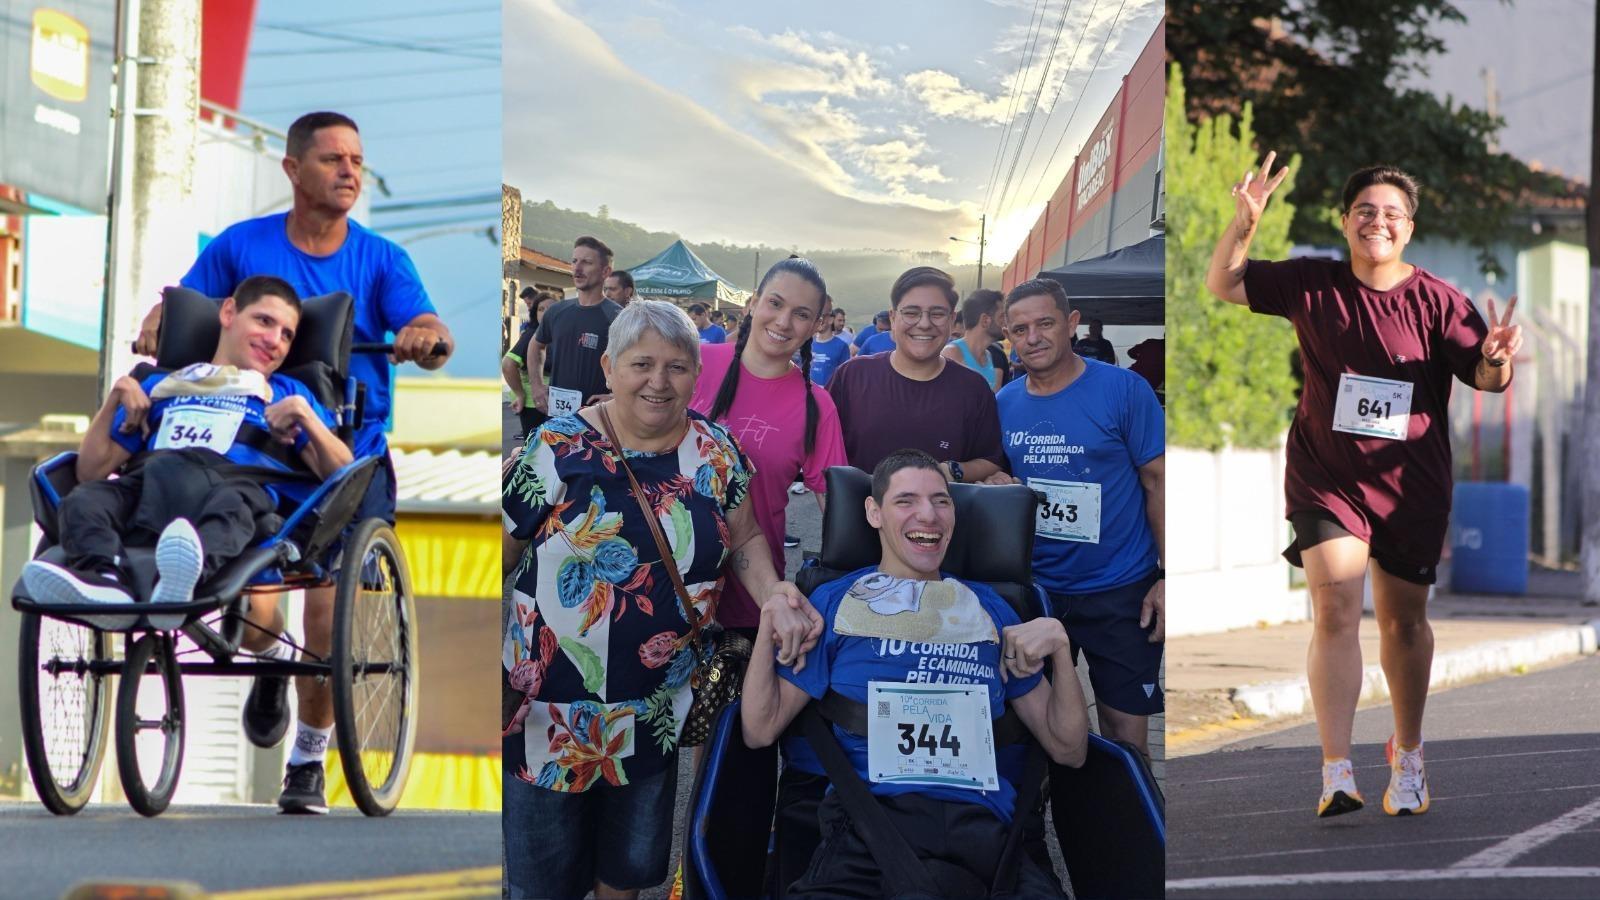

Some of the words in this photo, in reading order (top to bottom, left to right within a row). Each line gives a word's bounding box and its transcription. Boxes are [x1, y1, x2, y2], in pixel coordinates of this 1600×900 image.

[555, 399, 572, 412] 534
[1357, 397, 1392, 420] 641
[170, 425, 213, 443] 344
[1024, 434, 1066, 445] CORRIDA
[1028, 446, 1035, 454] E
[1035, 445, 1085, 455] CAMINHADA
[1023, 455, 1046, 464] PELA
[1048, 455, 1070, 464] VIDA
[1040, 501, 1078, 523] 343
[910, 642, 979, 661] CORRIDA
[918, 656, 926, 670] E
[928, 657, 996, 680] CAMINHADA
[905, 671, 945, 684] PELA
[913, 698, 948, 707] CORRIDA
[902, 704, 928, 715] PELA
[928, 713, 953, 724] VIDA
[897, 722, 961, 757] 344
